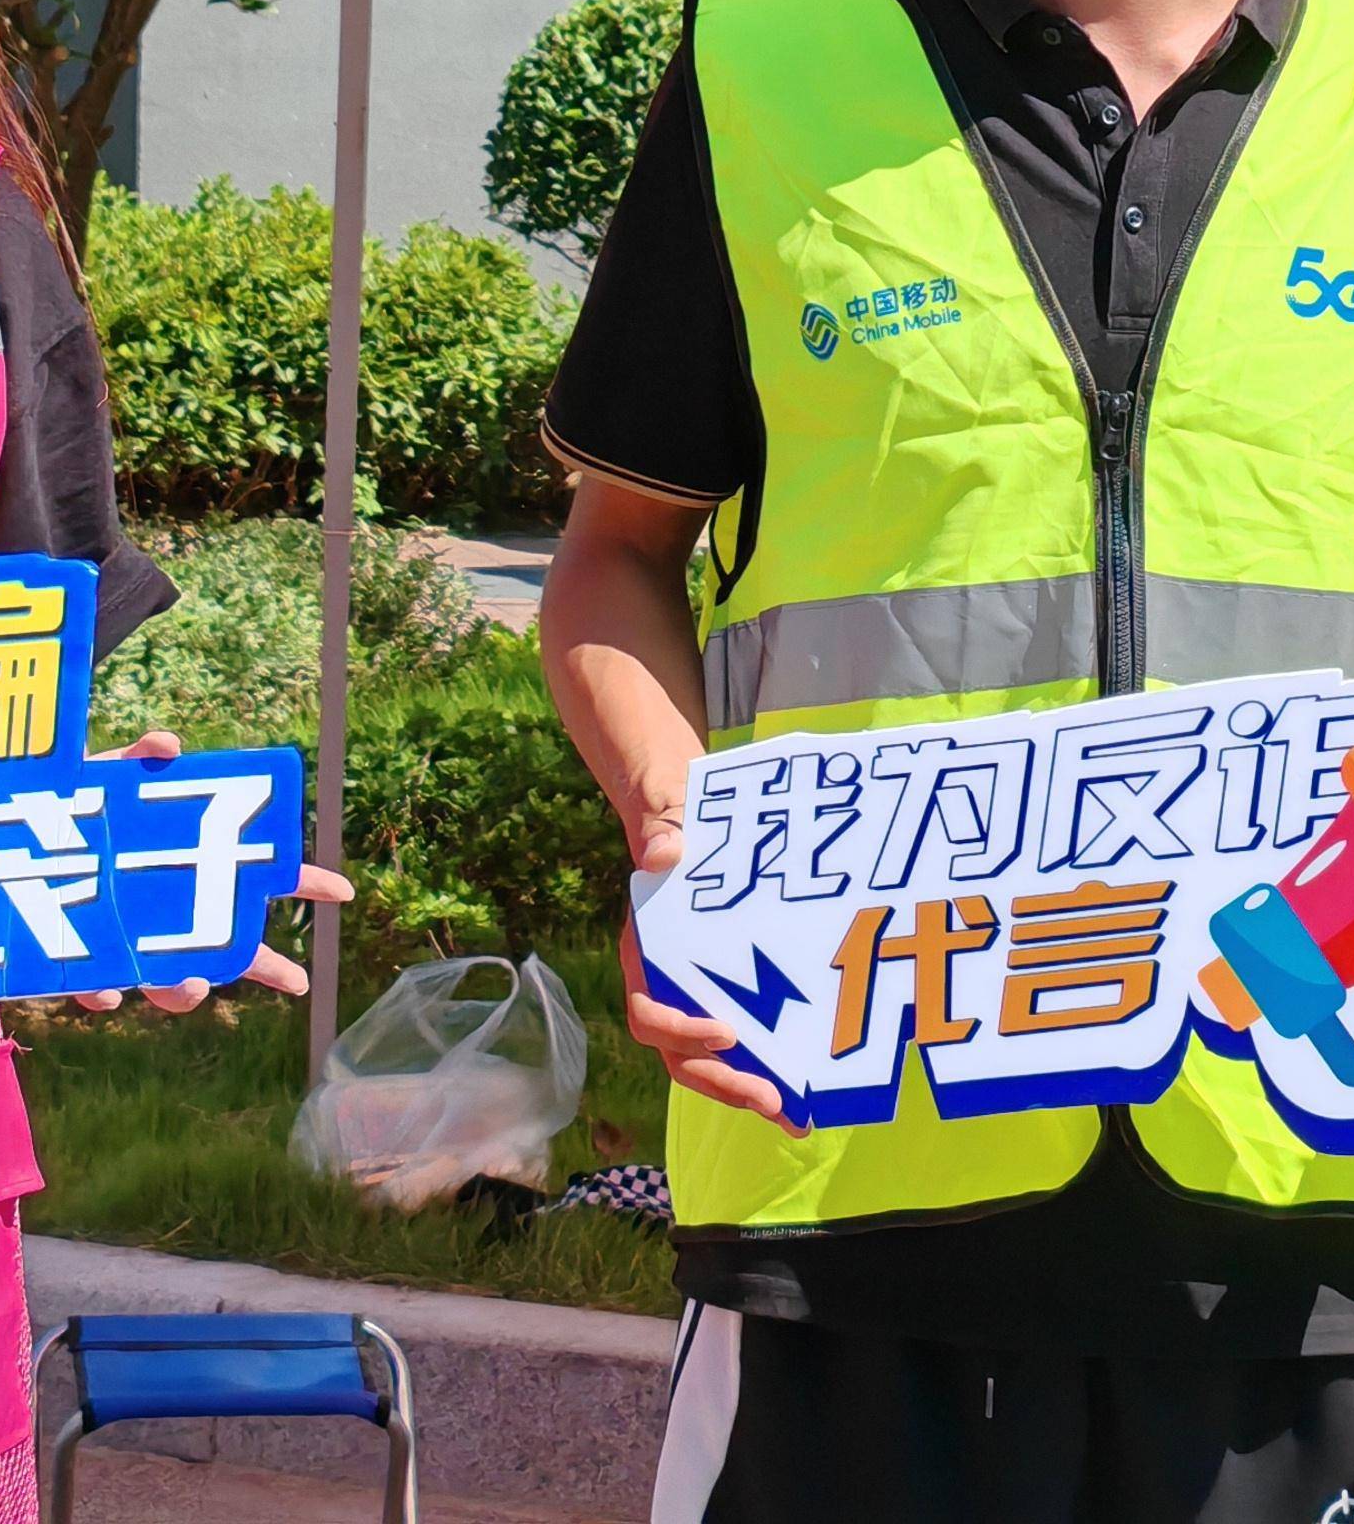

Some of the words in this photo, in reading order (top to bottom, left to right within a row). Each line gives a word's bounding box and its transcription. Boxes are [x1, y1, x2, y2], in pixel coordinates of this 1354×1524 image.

[845, 275, 959, 323] 中国移动
[851, 322, 901, 345] China
[903, 307, 962, 333] Mobile
[830, 879, 1178, 1060] 代言
